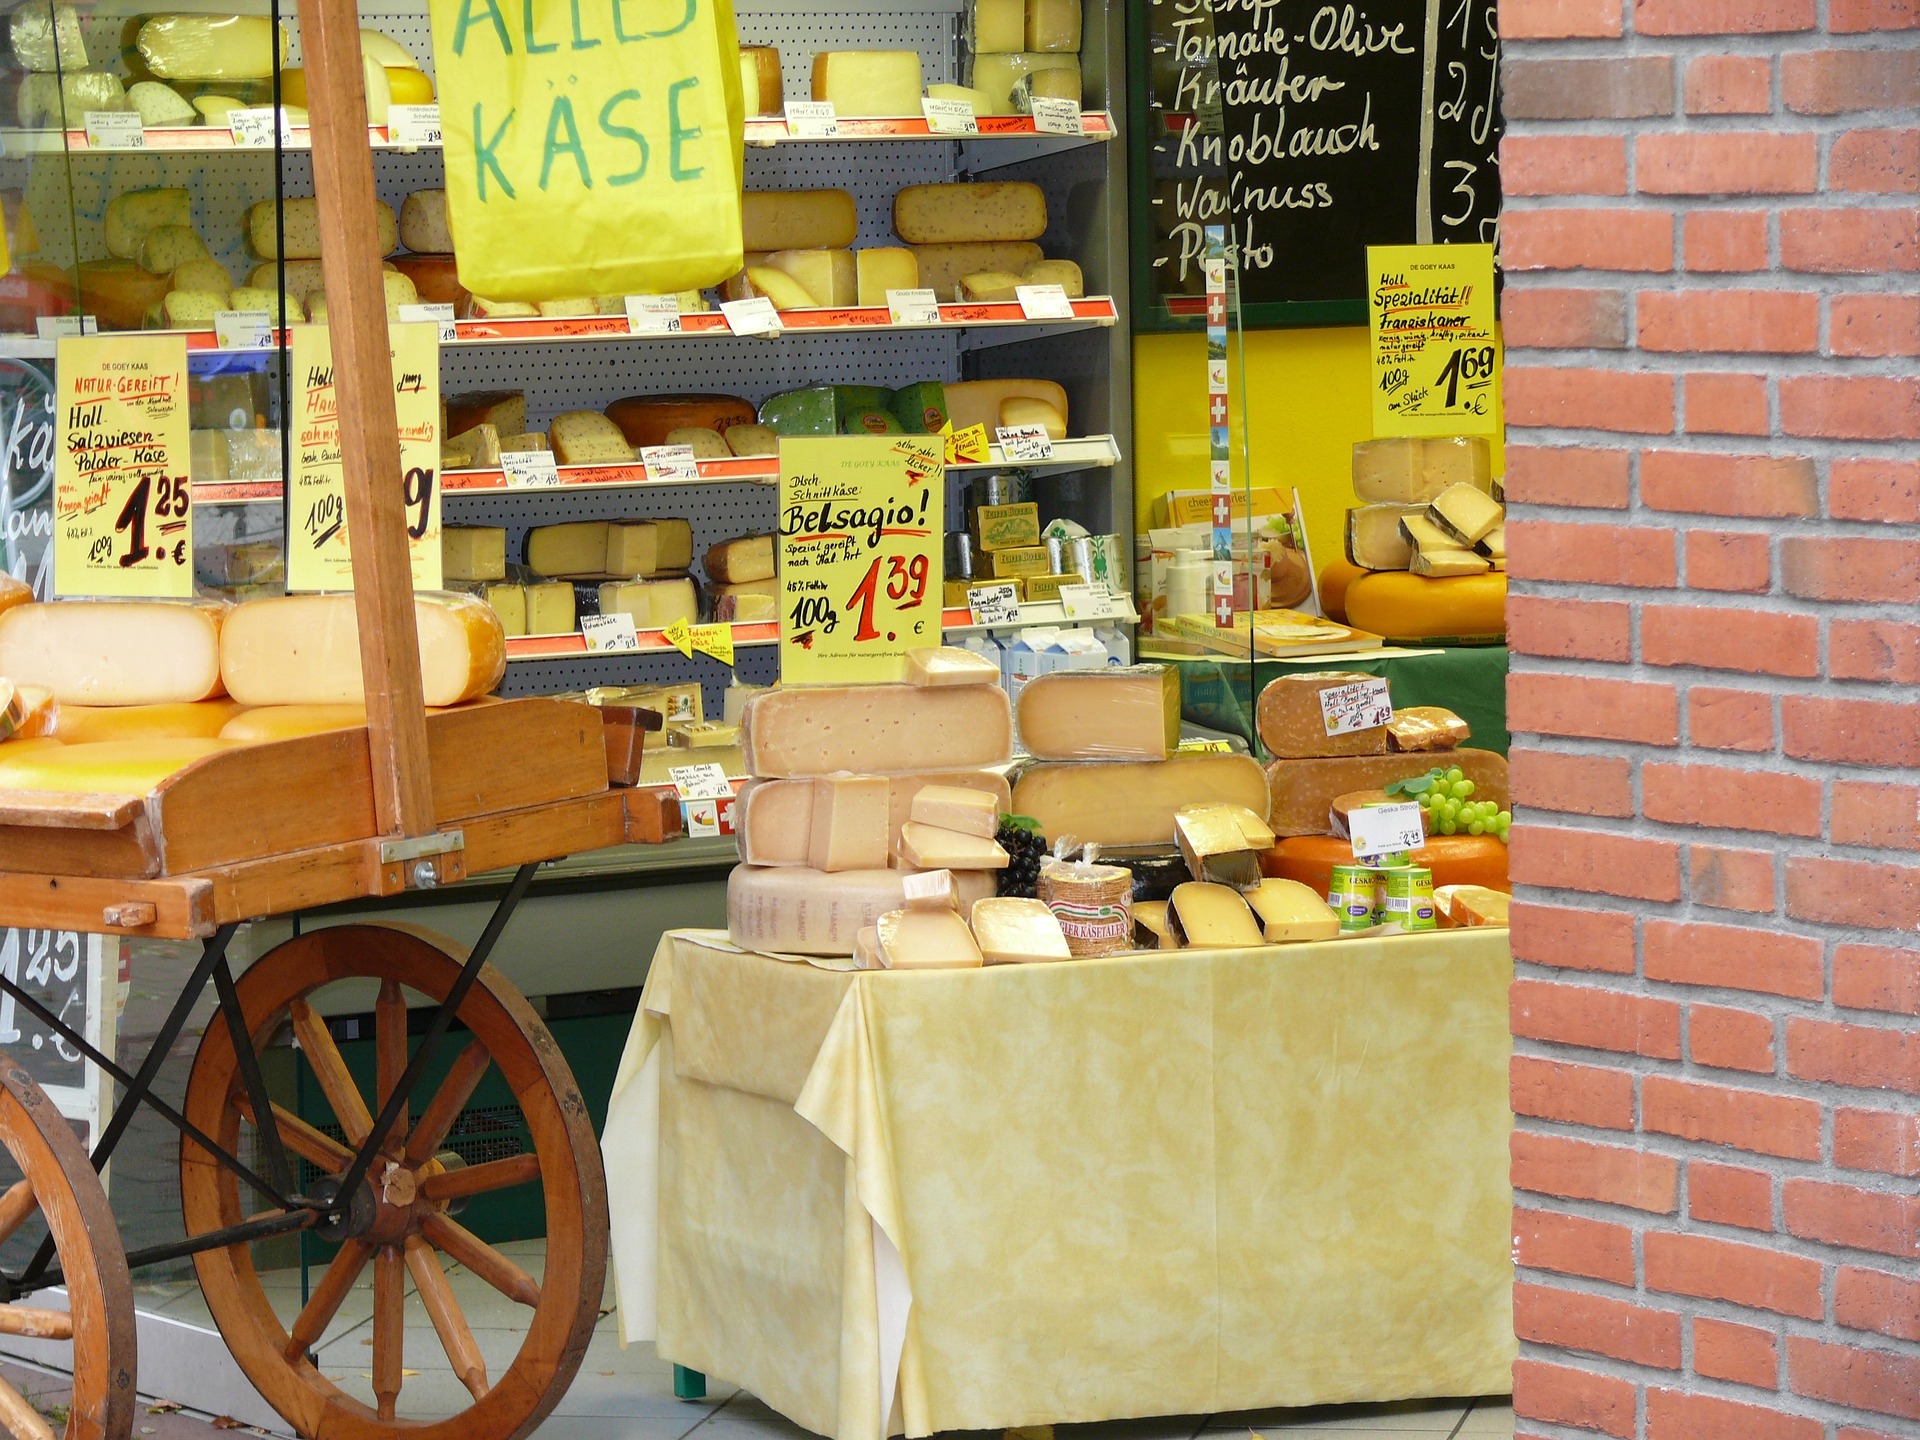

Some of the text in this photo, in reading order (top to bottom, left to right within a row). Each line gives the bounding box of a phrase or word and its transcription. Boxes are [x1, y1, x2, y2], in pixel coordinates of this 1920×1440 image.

[1174, 57, 1345, 110] Kräuter
[473, 75, 705, 204] KÄSE
[1177, 92, 1380, 167] Knoblauch
[1177, 171, 1333, 220] Walnuss
[1380, 273, 1408, 285] Holl.
[1379, 311, 1471, 329] Franziskaner
[1379, 368, 1410, 391] 100g
[1403, 387, 1429, 406] Stück
[133, 444, 168, 463] Käse
[896, 439, 936, 458] sehr sehr
[877, 460, 900, 468] KAAS
[304, 493, 344, 536] 100g
[778, 489, 930, 548] Belsagio!
[88, 535, 112, 561] 100g
[171, 539, 187, 566] €
[785, 536, 856, 556] Spezial gereift
[788, 556, 810, 567] nach
[843, 547, 862, 561] Art
[787, 580, 805, 592] 45%
[789, 596, 840, 634] 100g
[913, 621, 925, 634] €
